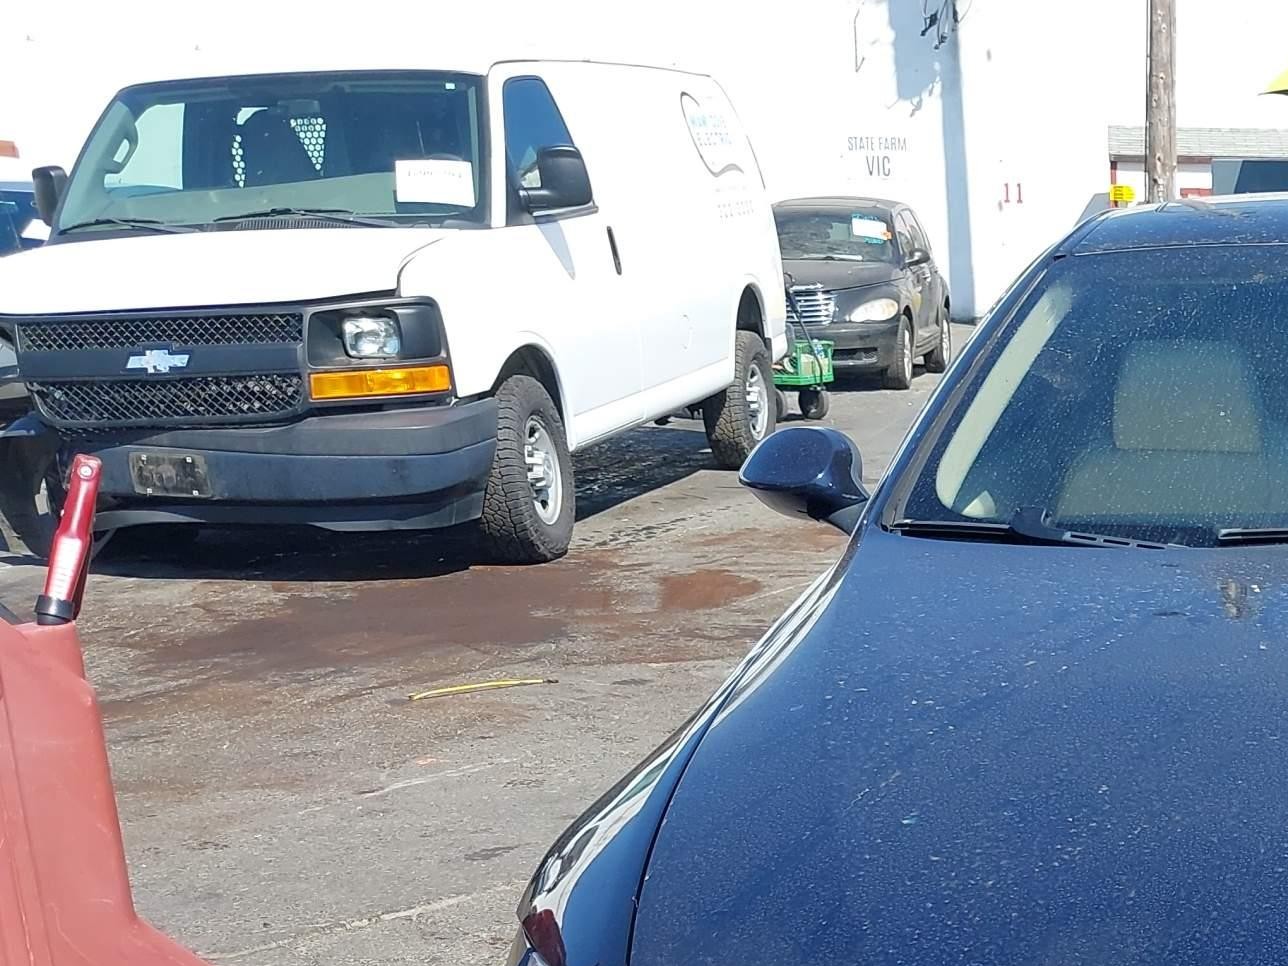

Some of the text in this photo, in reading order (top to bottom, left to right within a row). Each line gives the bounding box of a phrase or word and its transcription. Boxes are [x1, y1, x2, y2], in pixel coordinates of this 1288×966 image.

[847, 136, 907, 152] STATE FARM
[865, 155, 891, 177] VIC
[1003, 182, 1023, 204] 11
